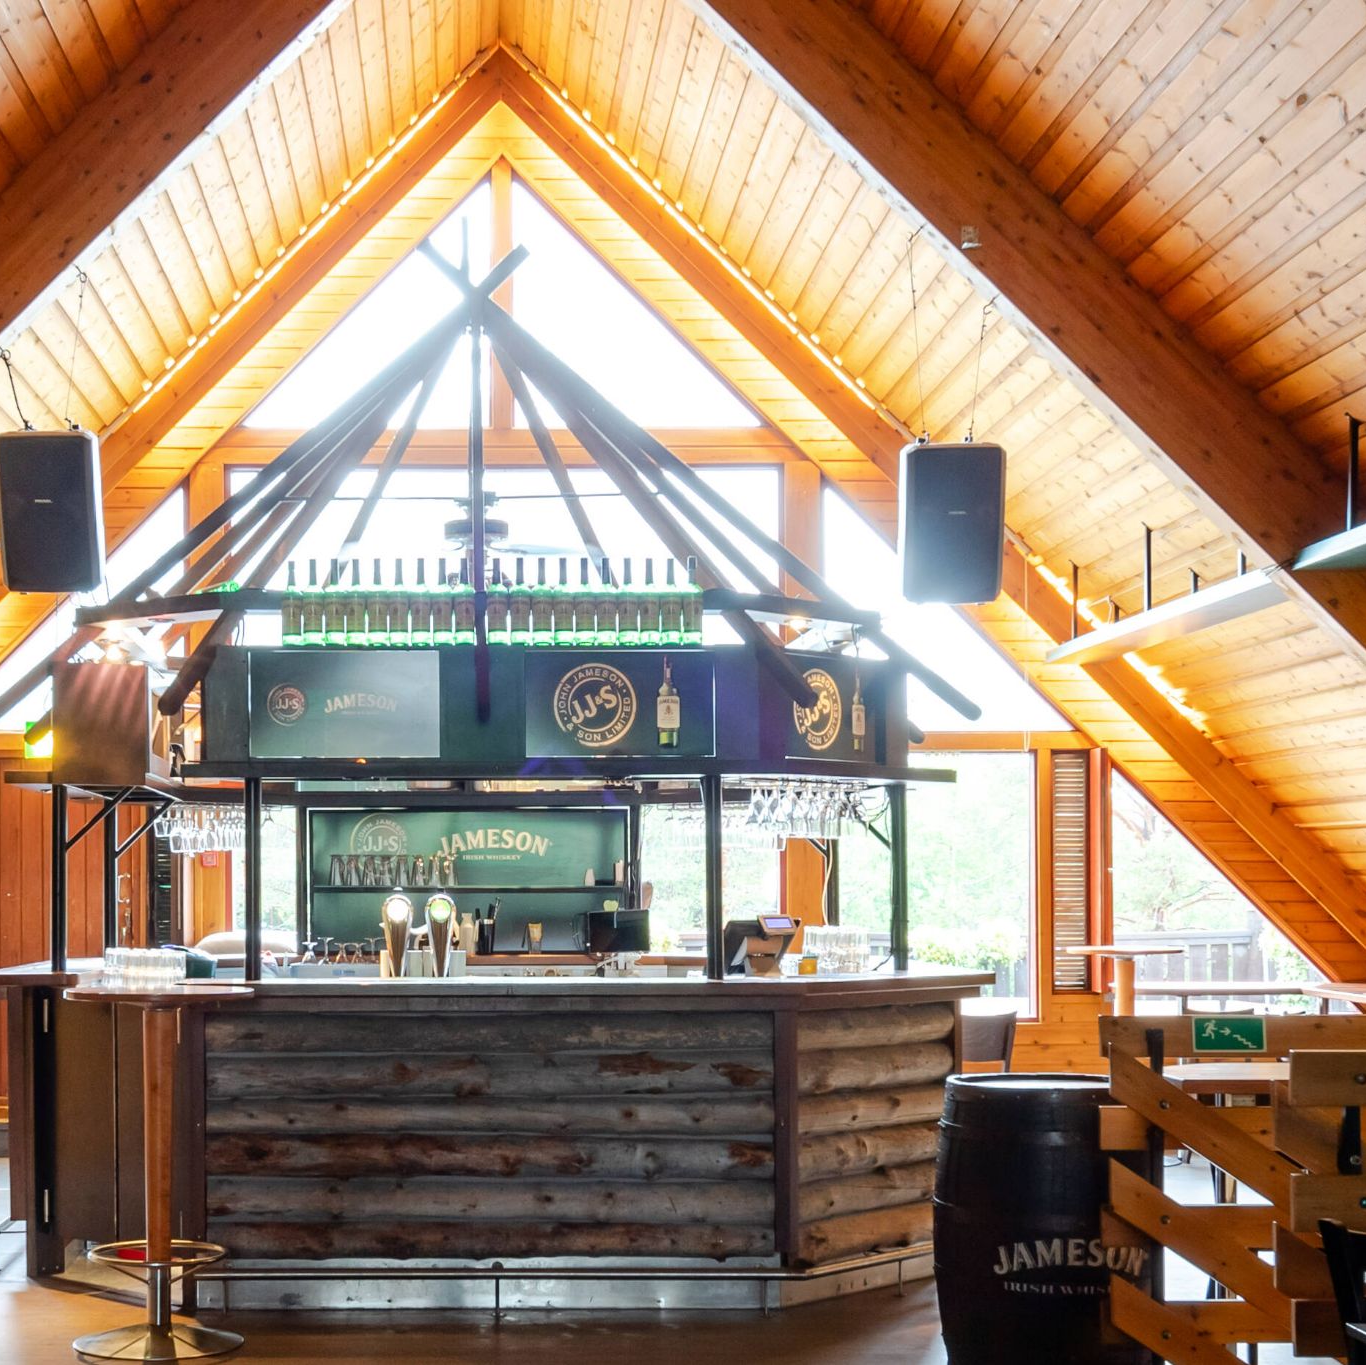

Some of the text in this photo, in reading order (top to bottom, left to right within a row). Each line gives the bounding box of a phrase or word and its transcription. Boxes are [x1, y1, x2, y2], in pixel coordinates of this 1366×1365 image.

[558, 668, 624, 714] JOHN JAMESON
[807, 674, 834, 694] AMESON
[324, 692, 397, 714] JAMESON
[566, 697, 631, 741] & SON LIMITED
[571, 685, 617, 724] JJ&S
[437, 828, 550, 857] JAMESON
[993, 1238, 1144, 1276] JAMESON
[1004, 1281, 1111, 1295] IRISH WHIS
